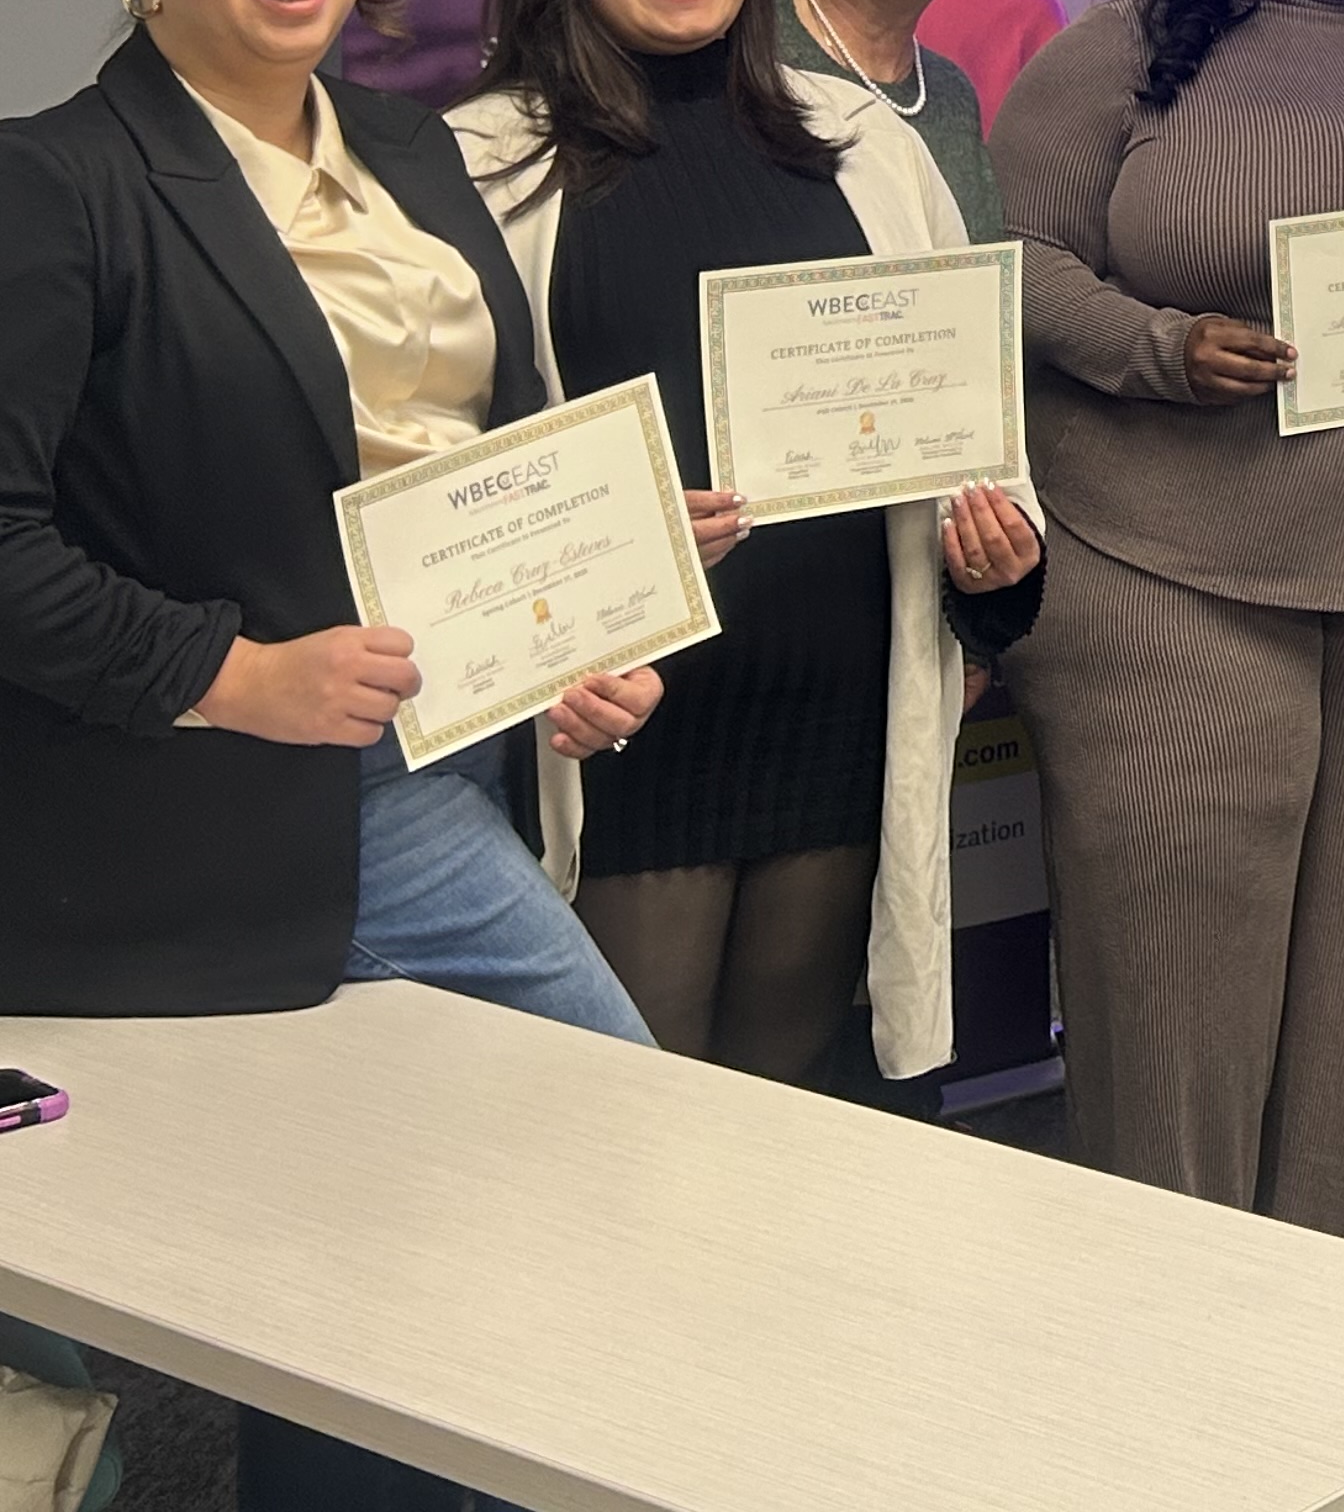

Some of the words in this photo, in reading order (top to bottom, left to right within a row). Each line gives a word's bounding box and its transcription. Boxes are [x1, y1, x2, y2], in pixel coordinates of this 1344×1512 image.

[770, 340, 850, 360] CERTIFICATE
[855, 338, 871, 350] OF
[876, 328, 956, 348] COMPLETION
[422, 528, 505, 568] CERTIFICATE
[507, 518, 525, 535] OF
[528, 485, 610, 526] COMPLETION
[444, 578, 503, 614] Rebeca
